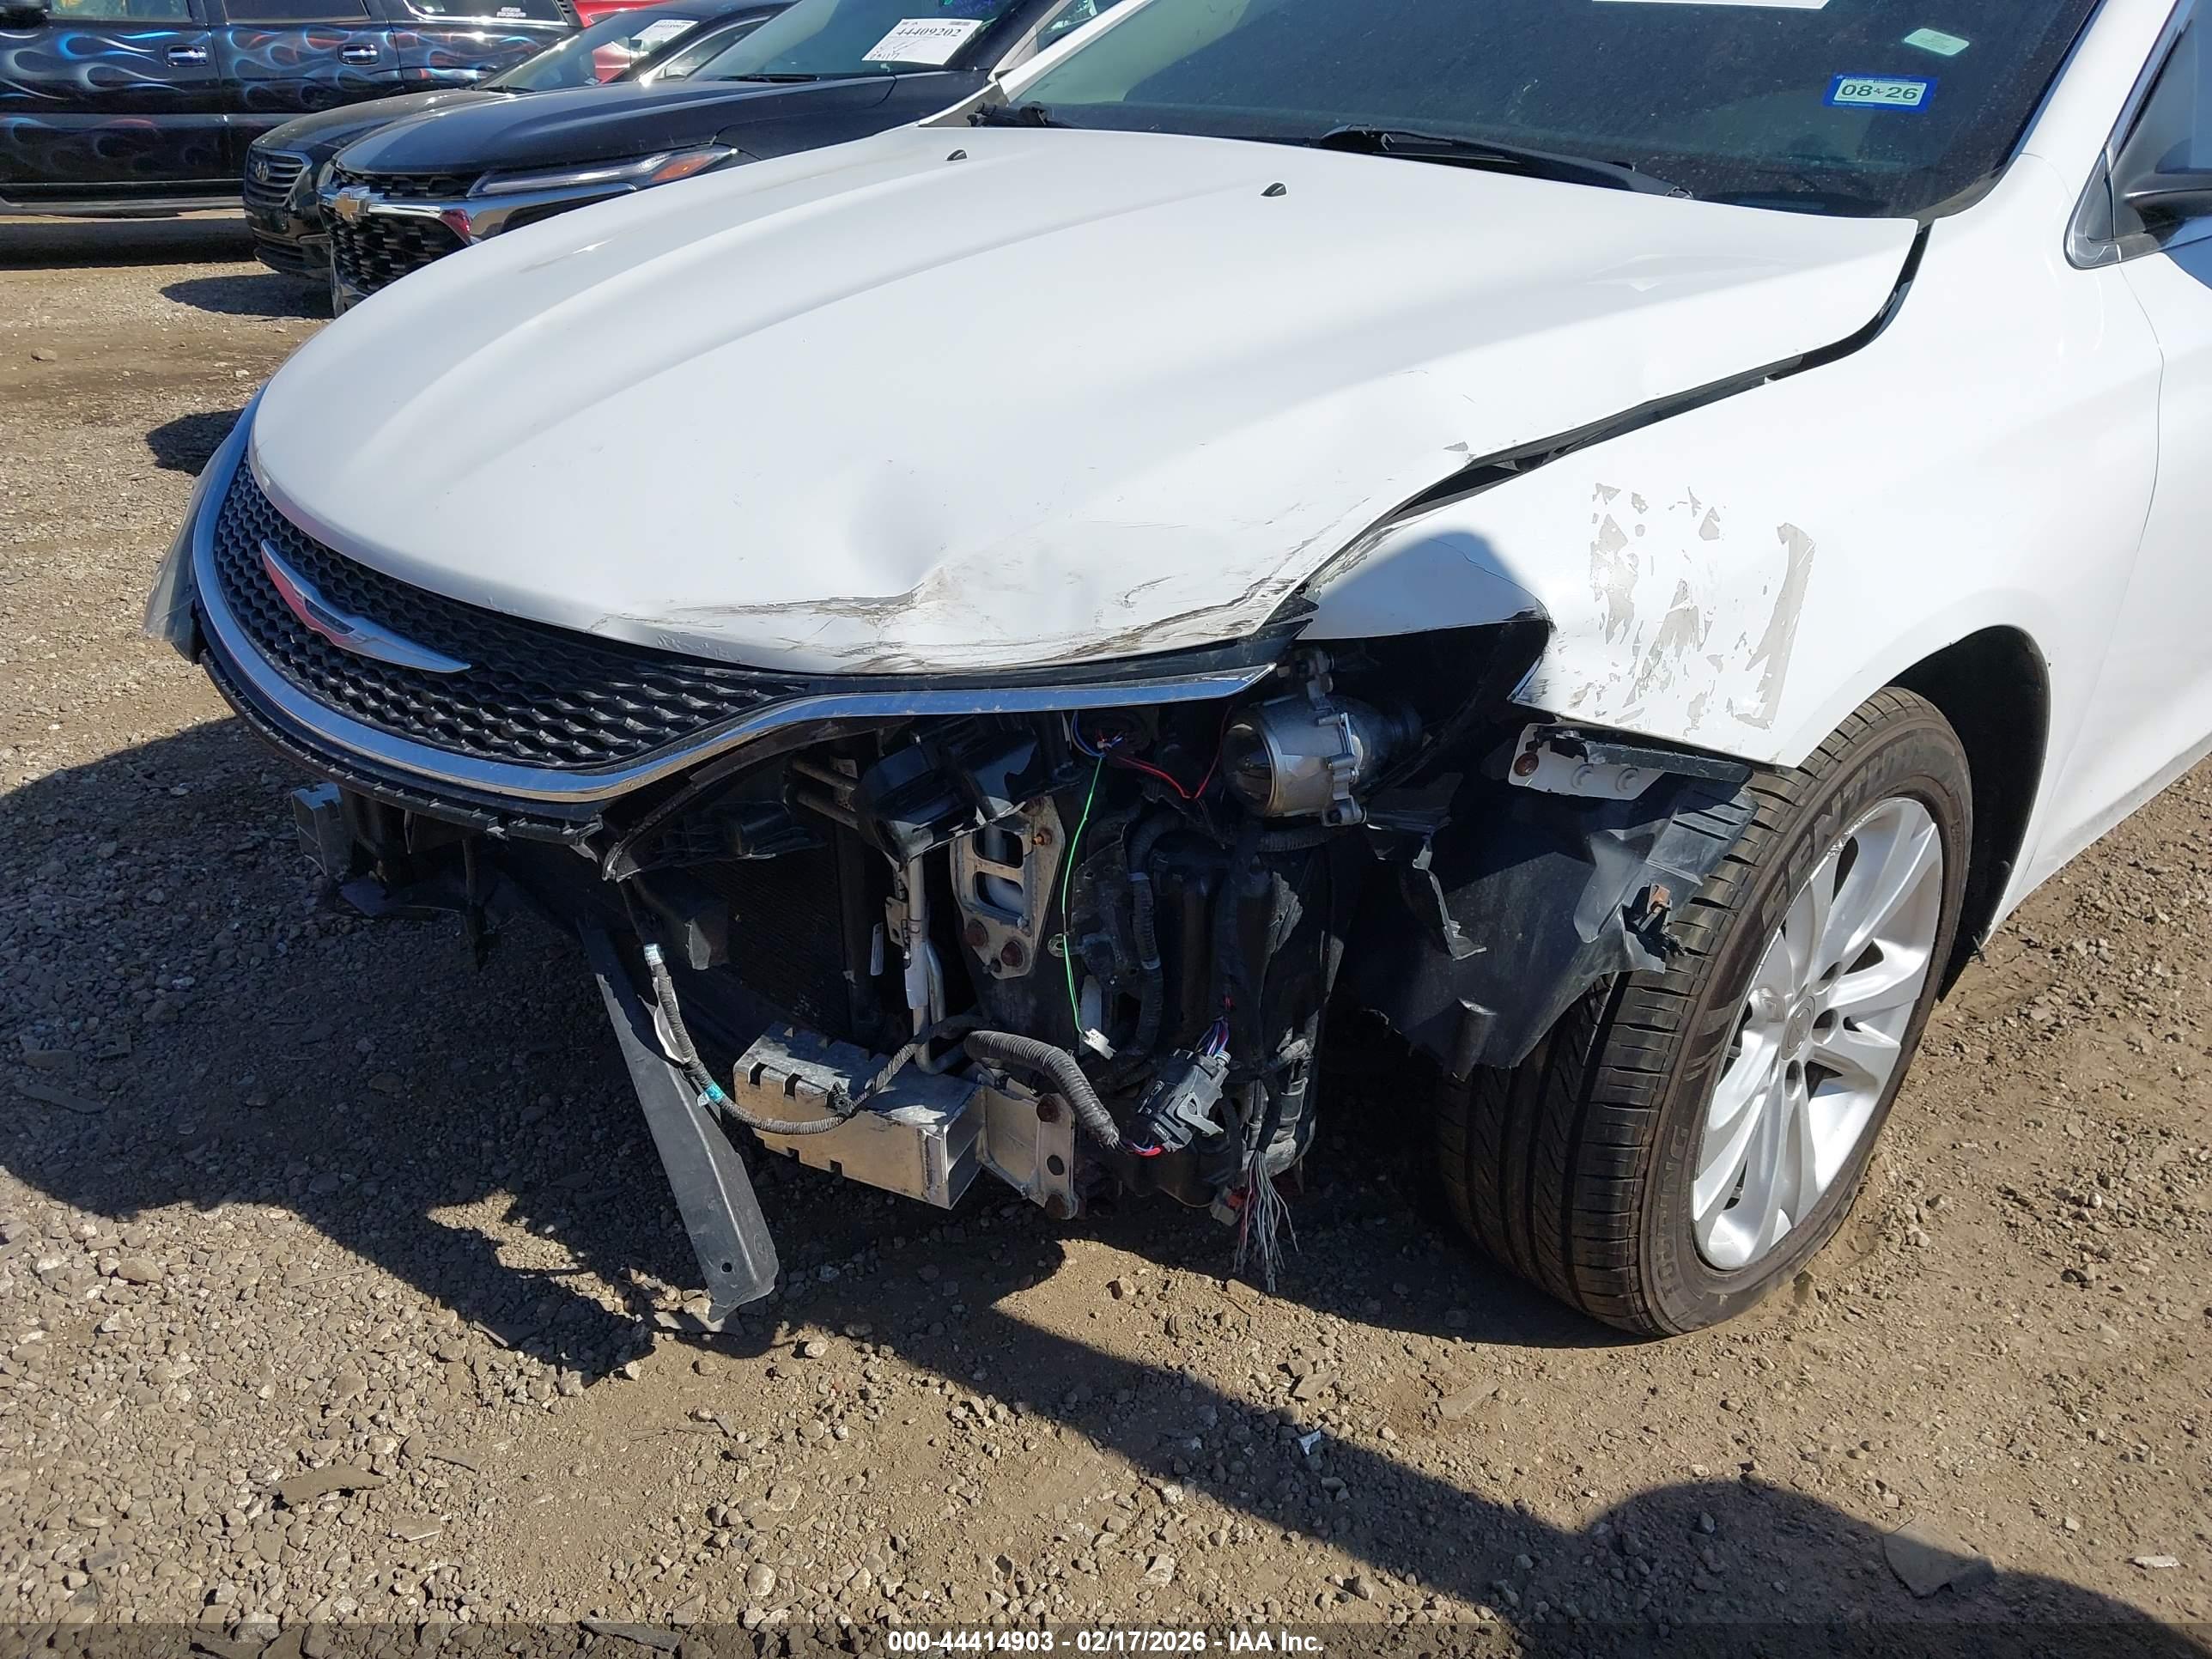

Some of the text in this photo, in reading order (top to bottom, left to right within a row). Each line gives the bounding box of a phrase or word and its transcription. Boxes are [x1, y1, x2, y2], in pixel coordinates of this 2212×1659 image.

[896, 27, 962, 37] 44409202
[1841, 84, 1919, 100] 08 26
